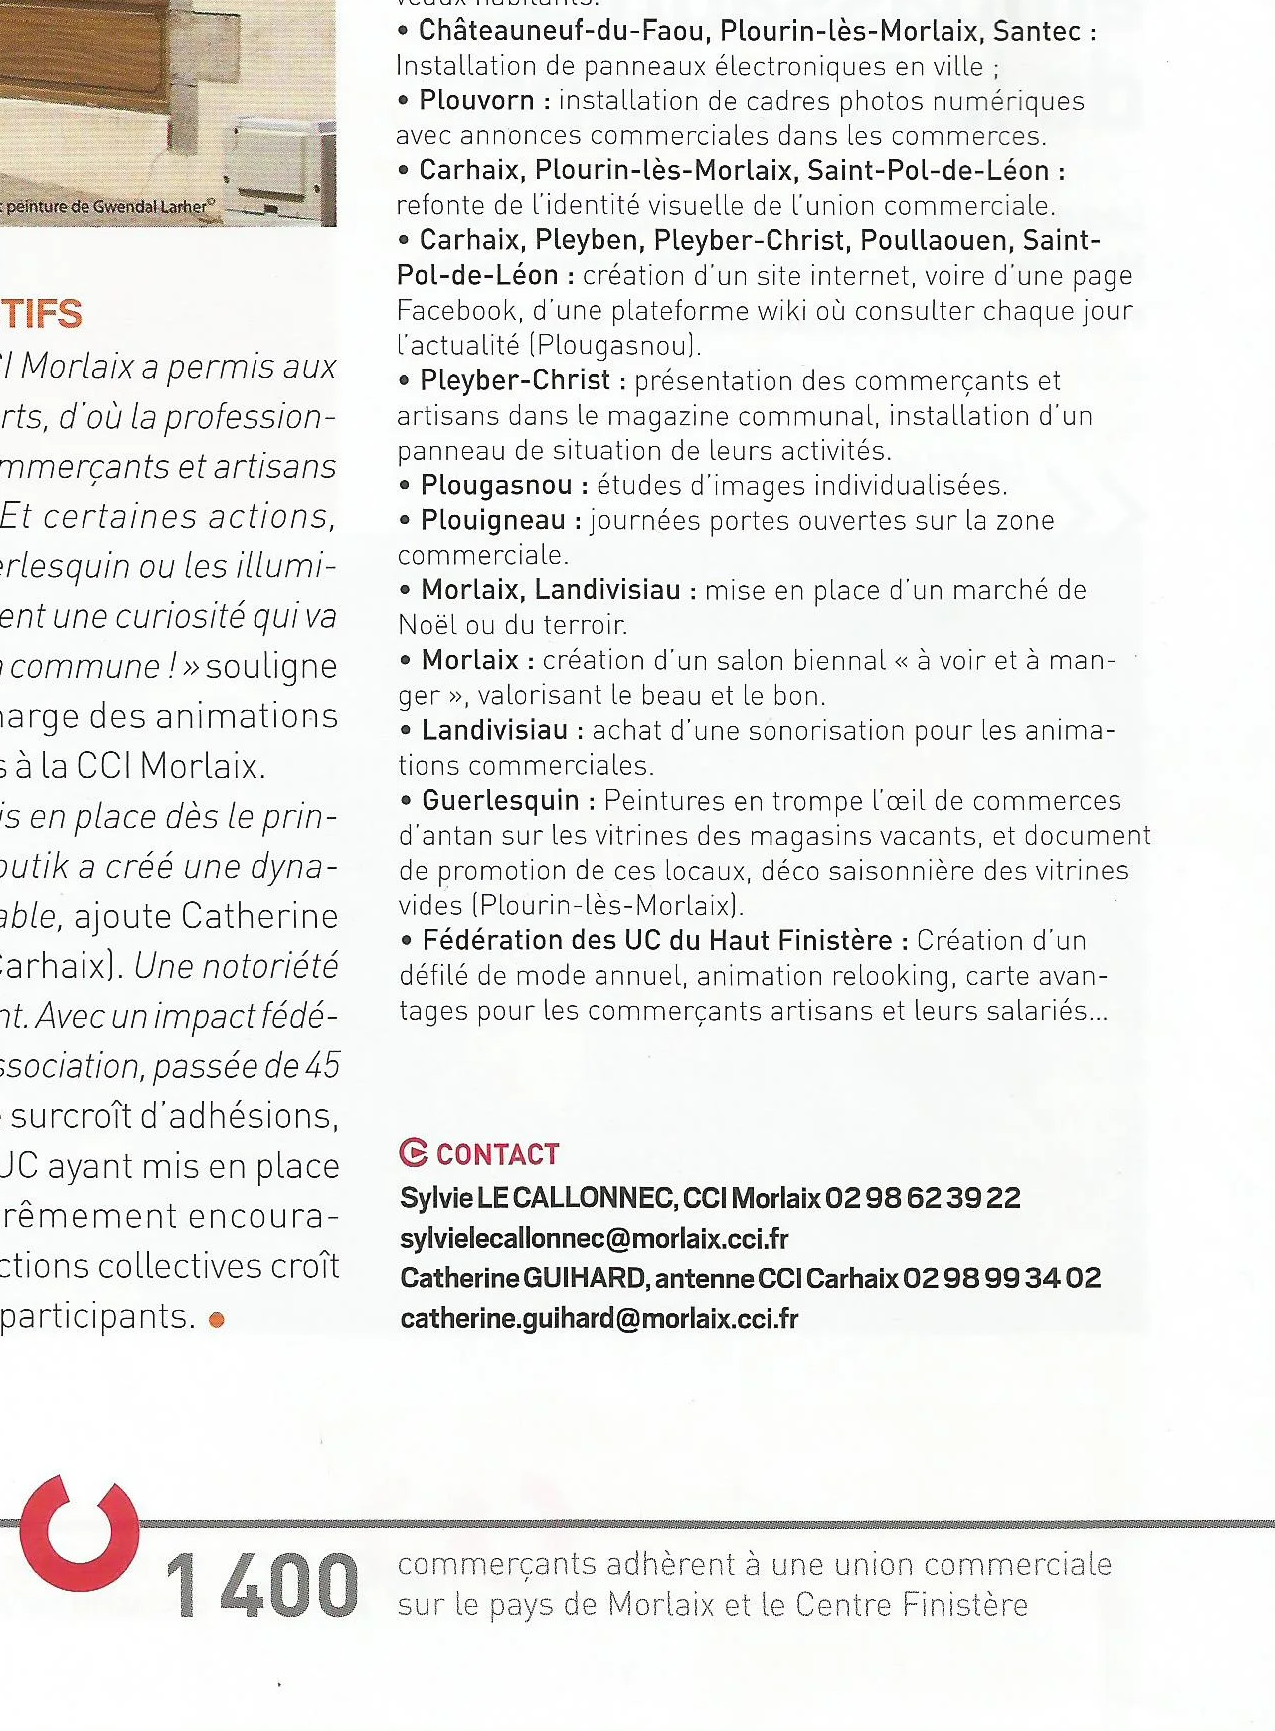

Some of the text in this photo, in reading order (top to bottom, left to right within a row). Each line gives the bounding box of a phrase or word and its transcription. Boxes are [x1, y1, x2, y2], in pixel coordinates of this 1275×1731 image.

[15, 749, 32, 779] à
[42, 750, 67, 779] la
[77, 750, 130, 779] CCI
[141, 750, 265, 779] Morlaix.
[436, 1142, 561, 1166] CONTACT
[400, 1184, 1021, 1215] Sylvie LE CALLONNEC, CCI Morlaix 02 98 62 39 22
[400, 1225, 790, 1255] sylvielecallonnec@morlaix.cci.fr
[400, 1305, 800, 1335] catherine.guihard@morlaix.cci.fr
[398, 1549, 1112, 1582] commerçants adhèrent à une union commerciale
[398, 1589, 1028, 1622] sur le pays de Morlaix et le Centre Finistère
